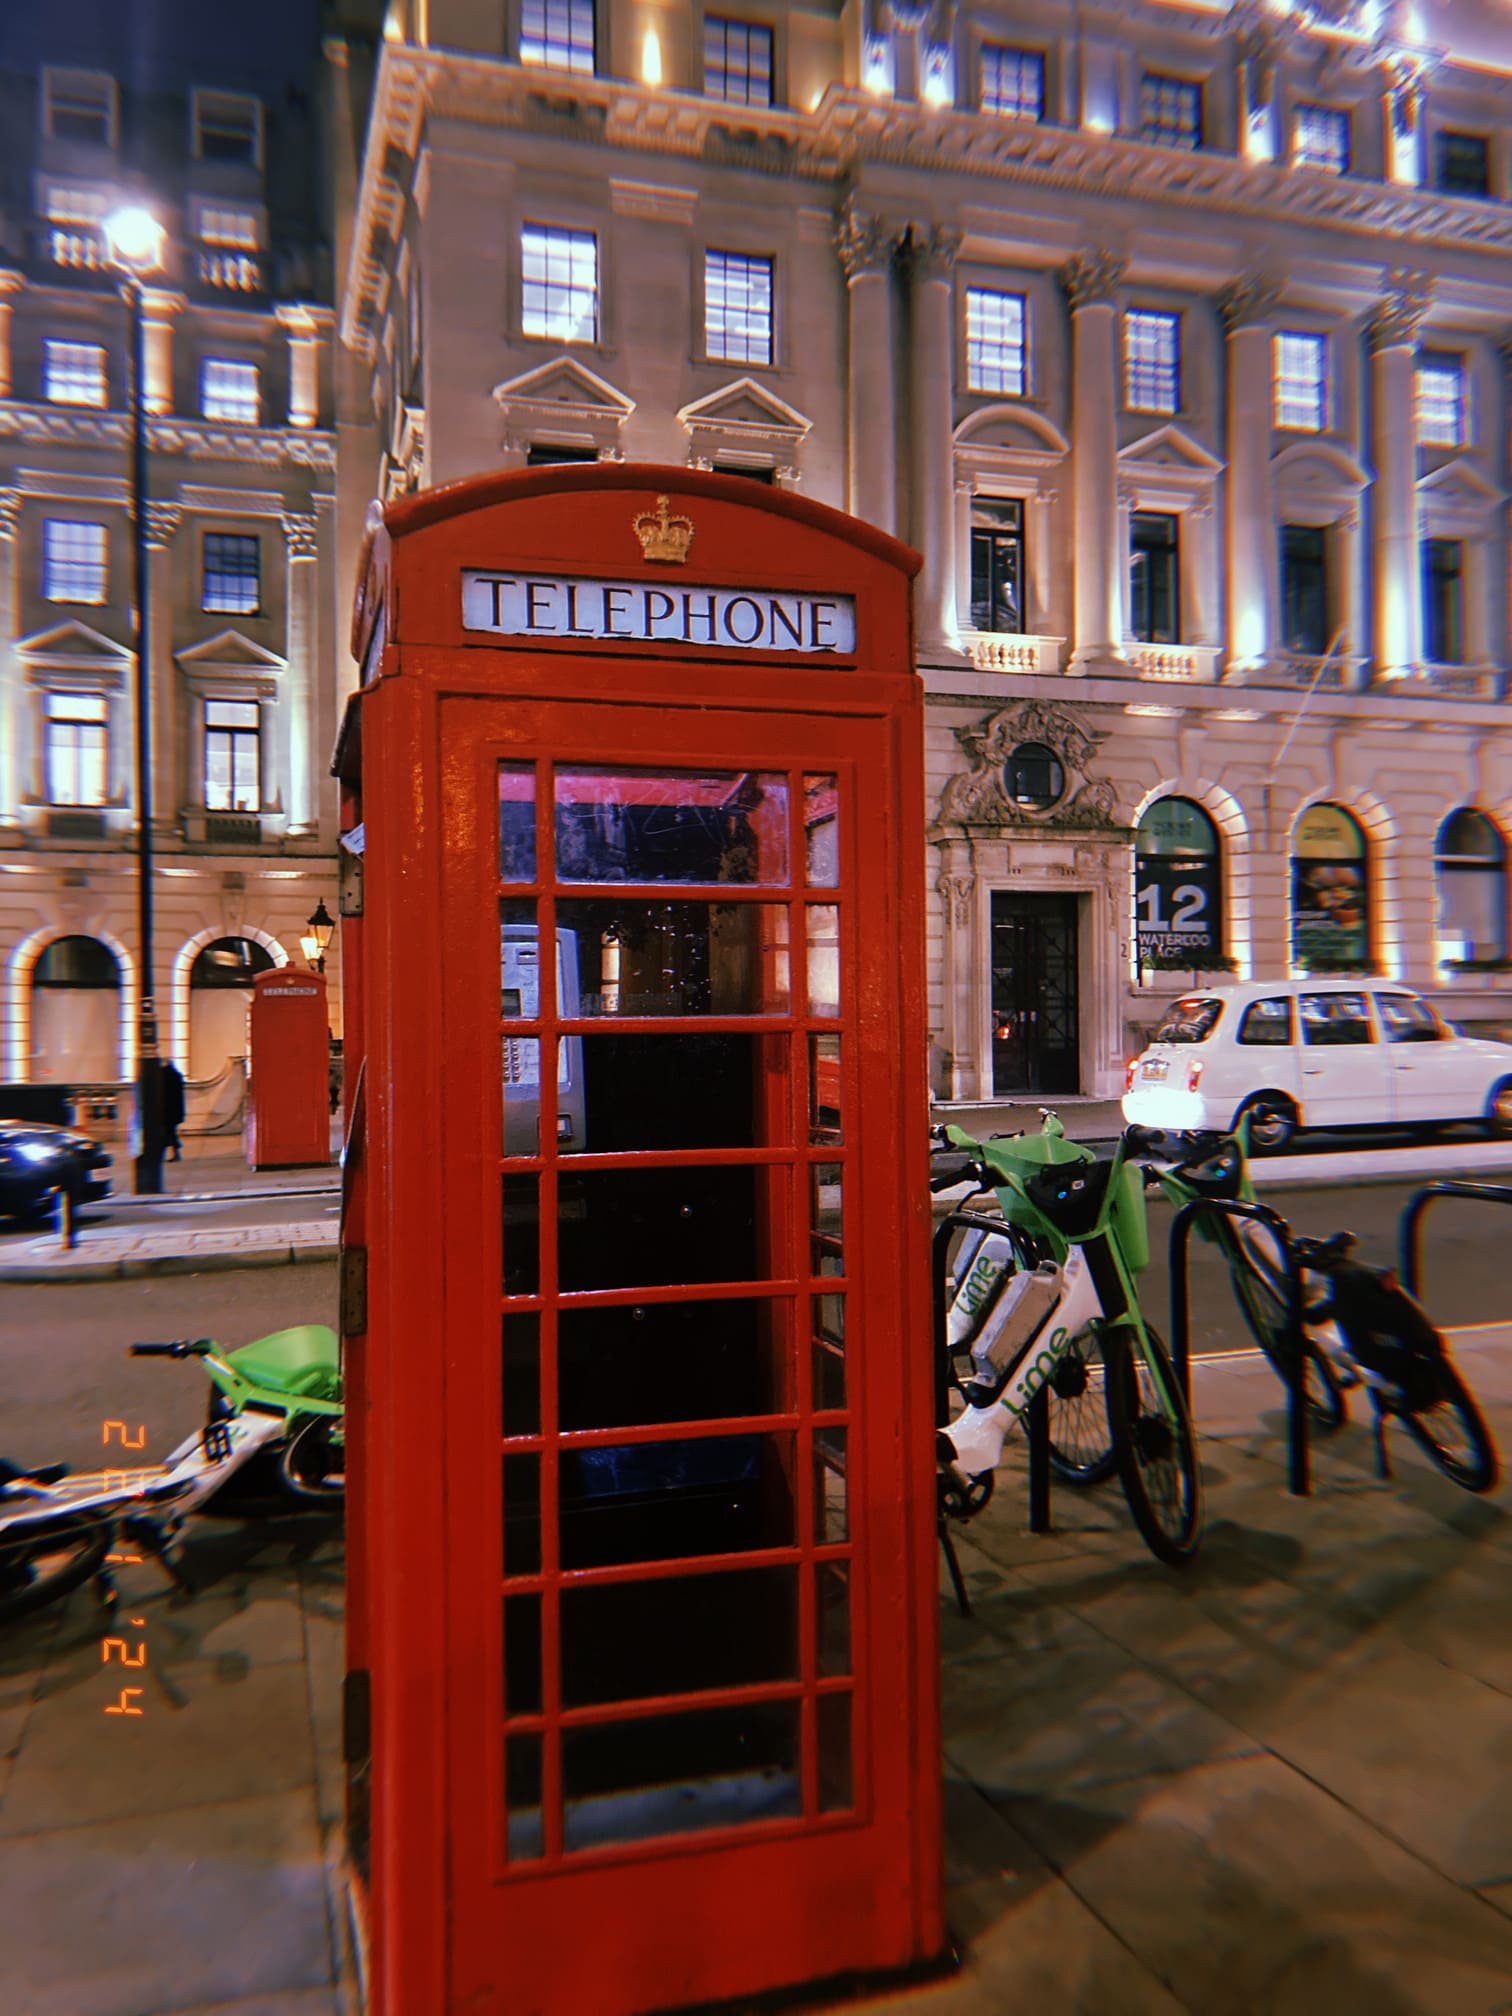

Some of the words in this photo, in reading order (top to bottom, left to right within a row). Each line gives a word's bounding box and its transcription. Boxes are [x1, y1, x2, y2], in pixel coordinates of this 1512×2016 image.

[475, 578, 837, 647] TELEPHONE
[1137, 883, 1209, 931] 12
[956, 1255, 1000, 1316] Lime
[1001, 1327, 1070, 1415] Lime
